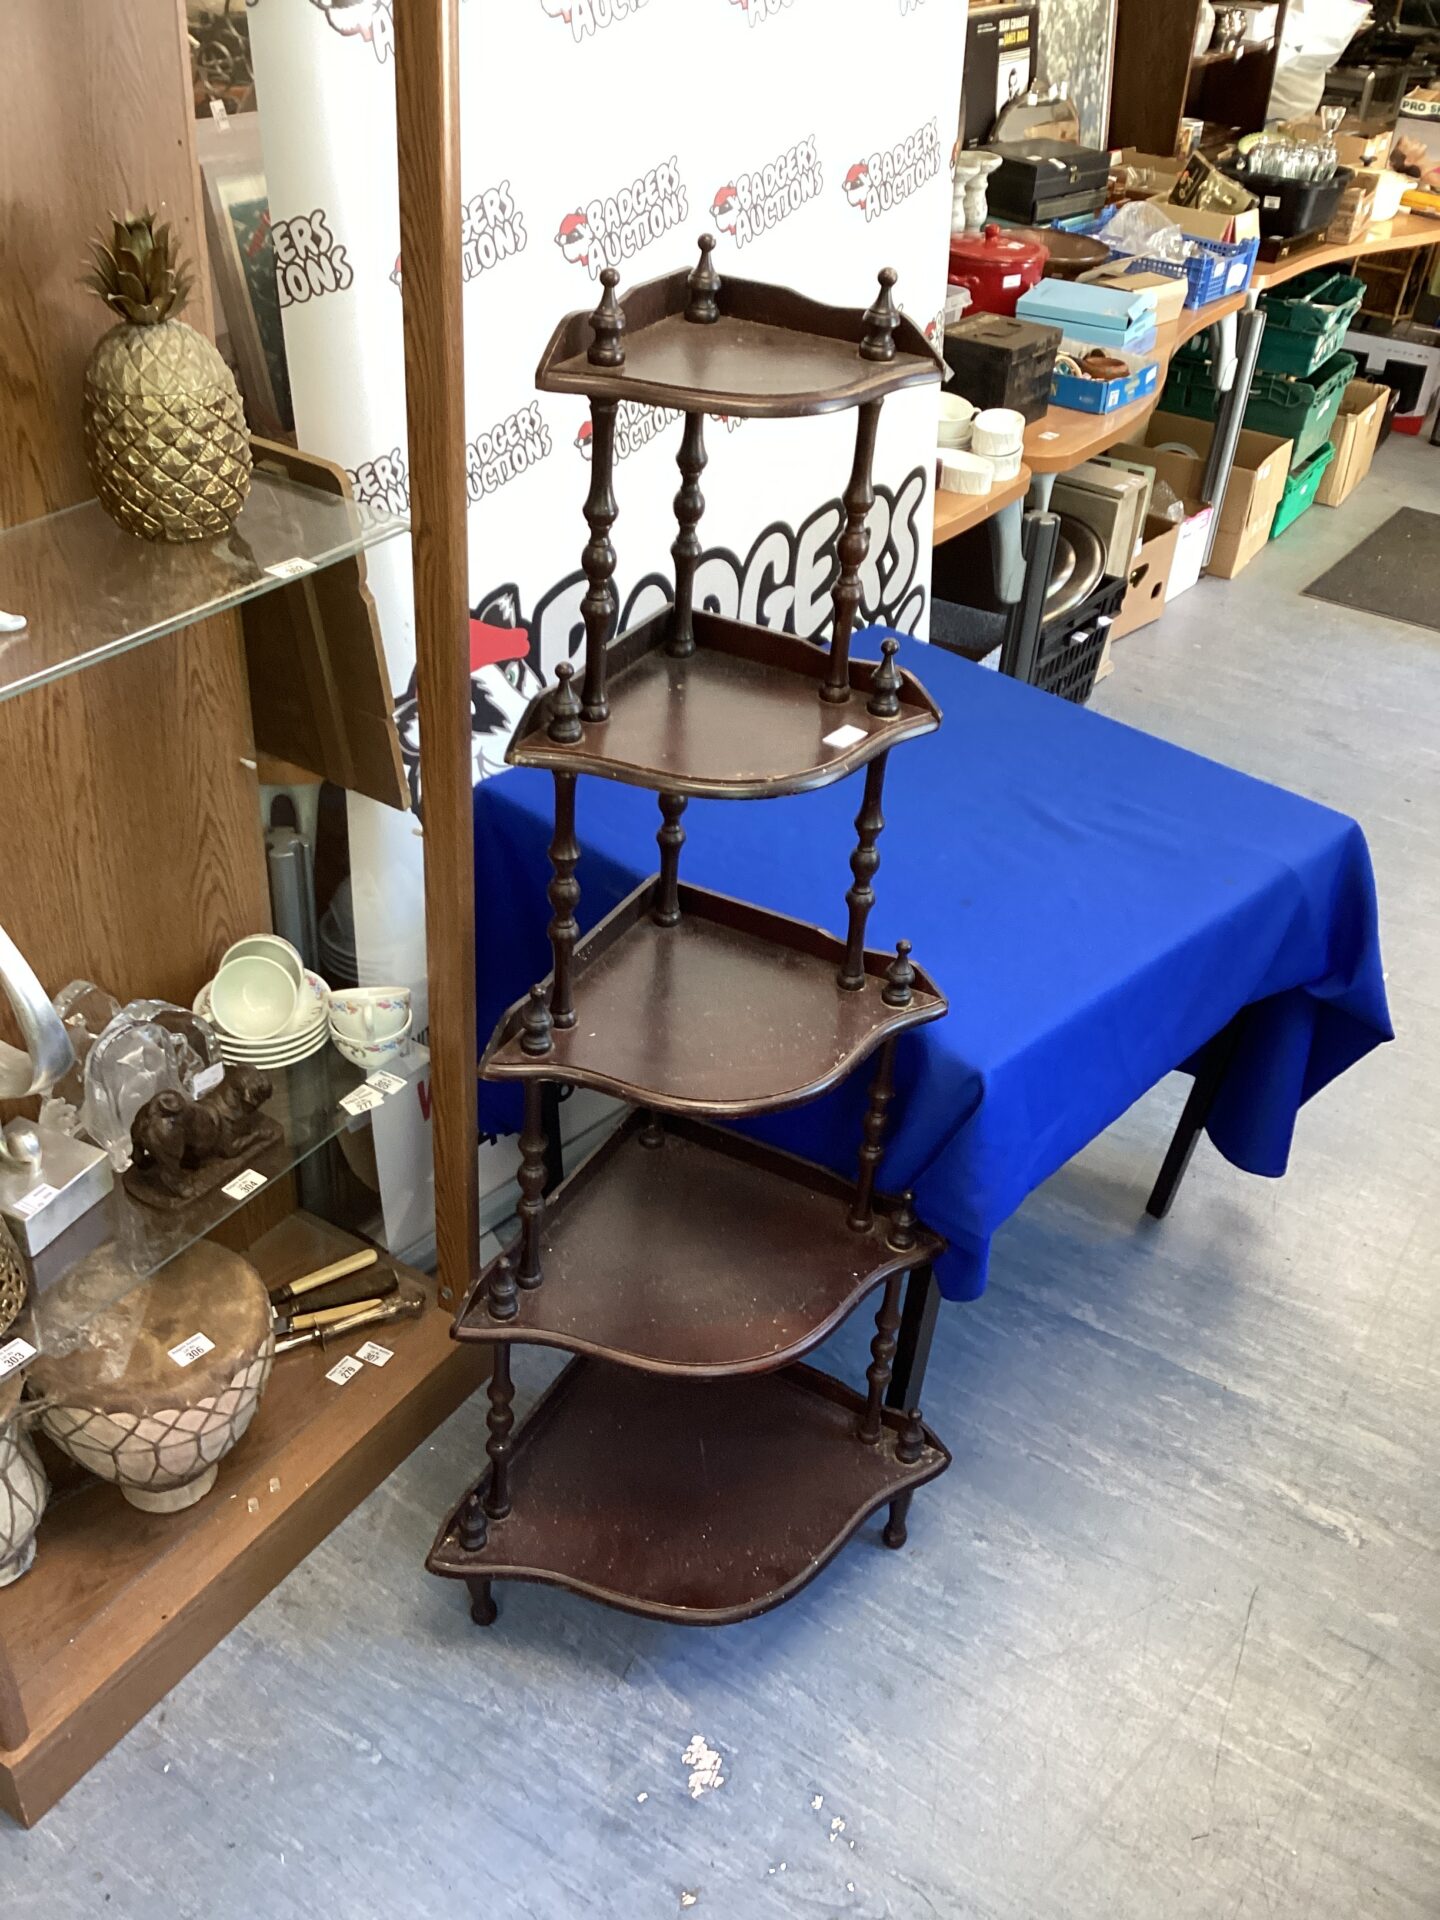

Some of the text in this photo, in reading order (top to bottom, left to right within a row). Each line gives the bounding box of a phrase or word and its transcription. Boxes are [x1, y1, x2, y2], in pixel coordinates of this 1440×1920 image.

[1402, 100, 1426, 111] PRO
[736, 133, 816, 212] BADGERS
[865, 141, 941, 223] AUCTIONS
[867, 115, 937, 188] BADGERS
[586, 155, 680, 241] BADGERS
[588, 184, 688, 281] AUCTIONS
[736, 161, 823, 249] AUCTIONS
[240, 1180, 259, 1194] 304
[4, 1352, 25, 1367] 303
[186, 1345, 206, 1360] 306
[341, 1366, 357, 1379] 279
